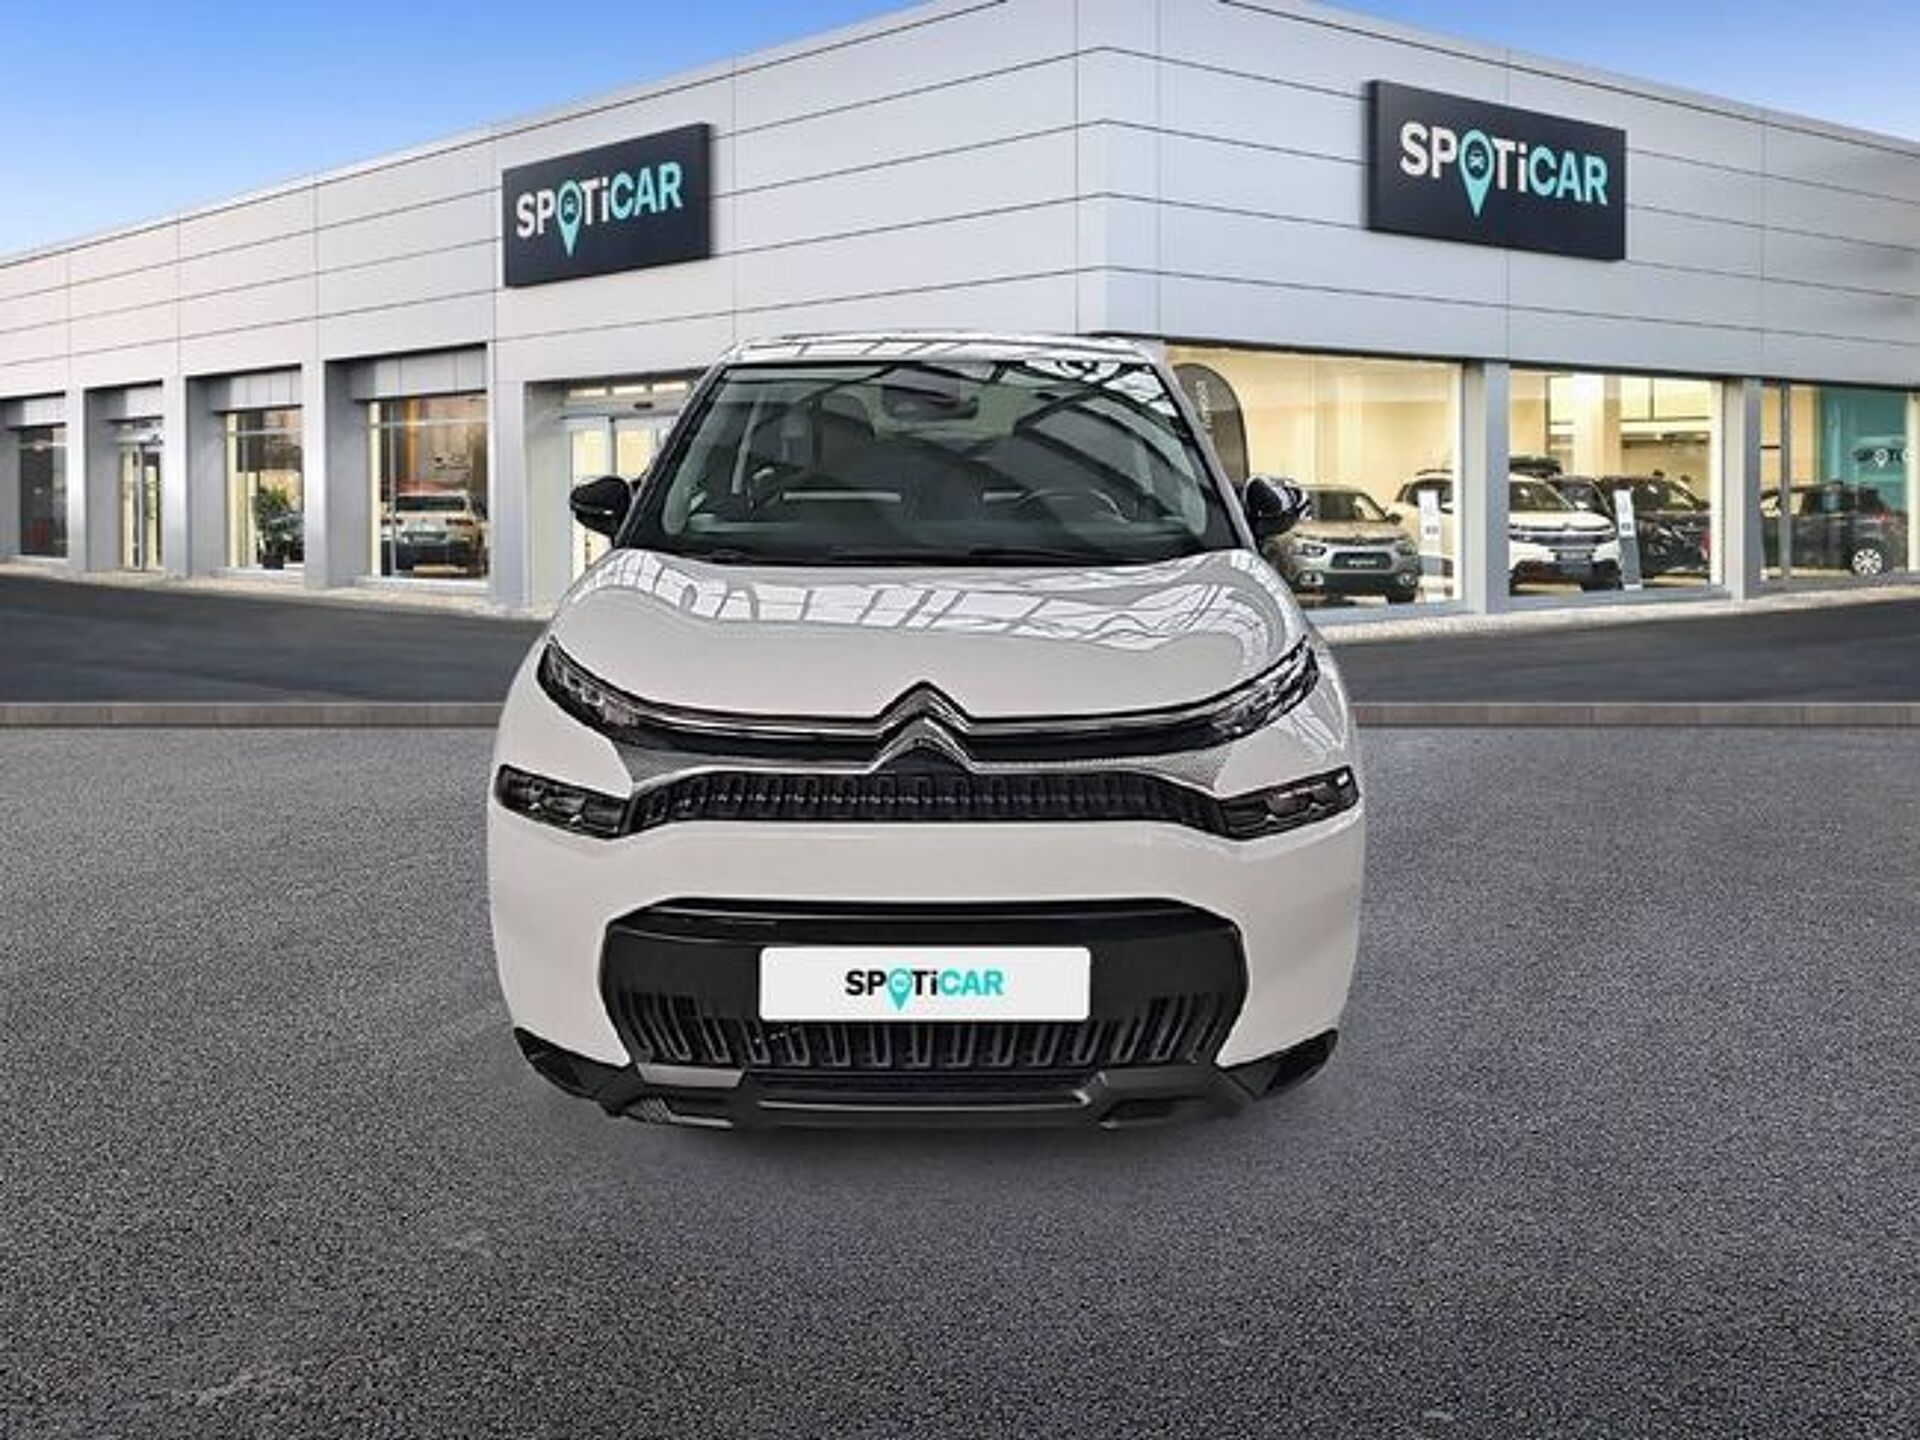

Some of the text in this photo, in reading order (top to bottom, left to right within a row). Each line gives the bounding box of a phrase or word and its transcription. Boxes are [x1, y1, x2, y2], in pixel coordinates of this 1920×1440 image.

[516, 161, 683, 257] SPOTiCAR
[1400, 121, 1608, 217] SPOTiCAR
[845, 968, 1004, 1011] SPOTiCAR
